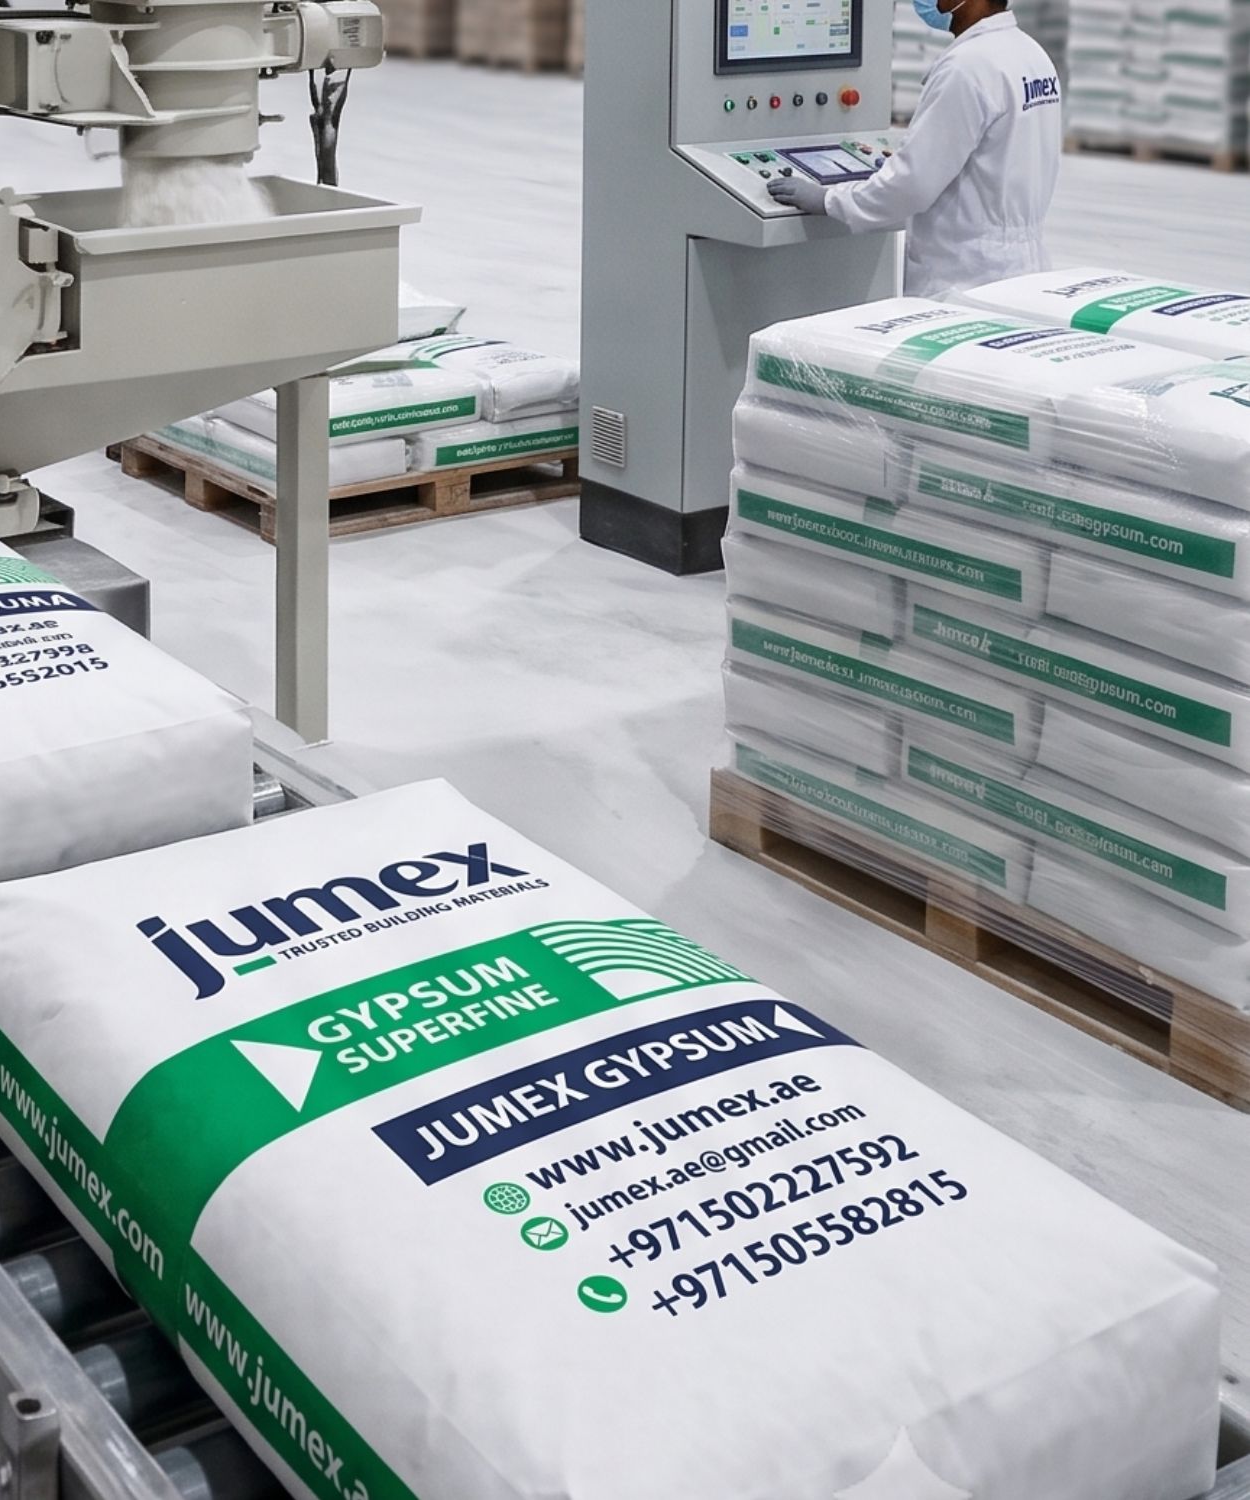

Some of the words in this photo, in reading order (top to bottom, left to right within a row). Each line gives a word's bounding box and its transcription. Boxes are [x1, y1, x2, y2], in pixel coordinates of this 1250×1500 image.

[136, 842, 530, 1000] jumex
[278, 928, 362, 960] TRUSTED
[363, 902, 452, 933] BUILDING
[452, 878, 550, 908] MATERIALS
[307, 956, 530, 1044] GYPSUM
[336, 983, 559, 1074] SUPERFINE
[416, 1073, 589, 1161] JUMEX
[583, 1016, 779, 1090] GYPSUM
[526, 1070, 822, 1191] www.jumex.ae
[0, 1064, 165, 1281] www.jumex.com
[564, 1104, 866, 1231] jumex.ae@gmail.com
[608, 1134, 919, 1269] +971502227592
[652, 1169, 968, 1317] +971505582815
